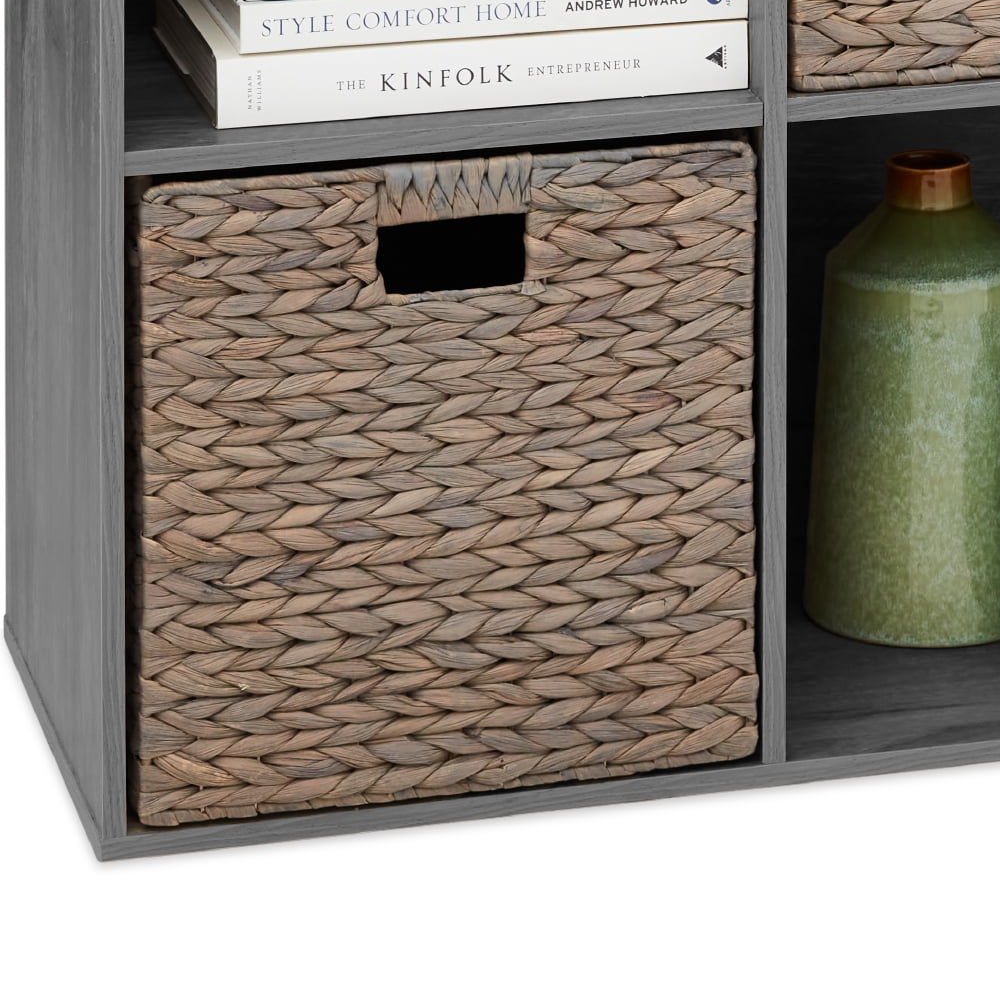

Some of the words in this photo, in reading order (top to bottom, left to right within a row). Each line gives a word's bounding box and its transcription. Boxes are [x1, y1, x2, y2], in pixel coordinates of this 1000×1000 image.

[261, 14, 335, 37] STYLE
[346, 5, 466, 31] COMFORT
[476, 0, 547, 22] HOME
[336, 78, 367, 92] THE
[380, 63, 513, 92] KINFOLK
[527, 58, 641, 77] ENTREPRENEUR
